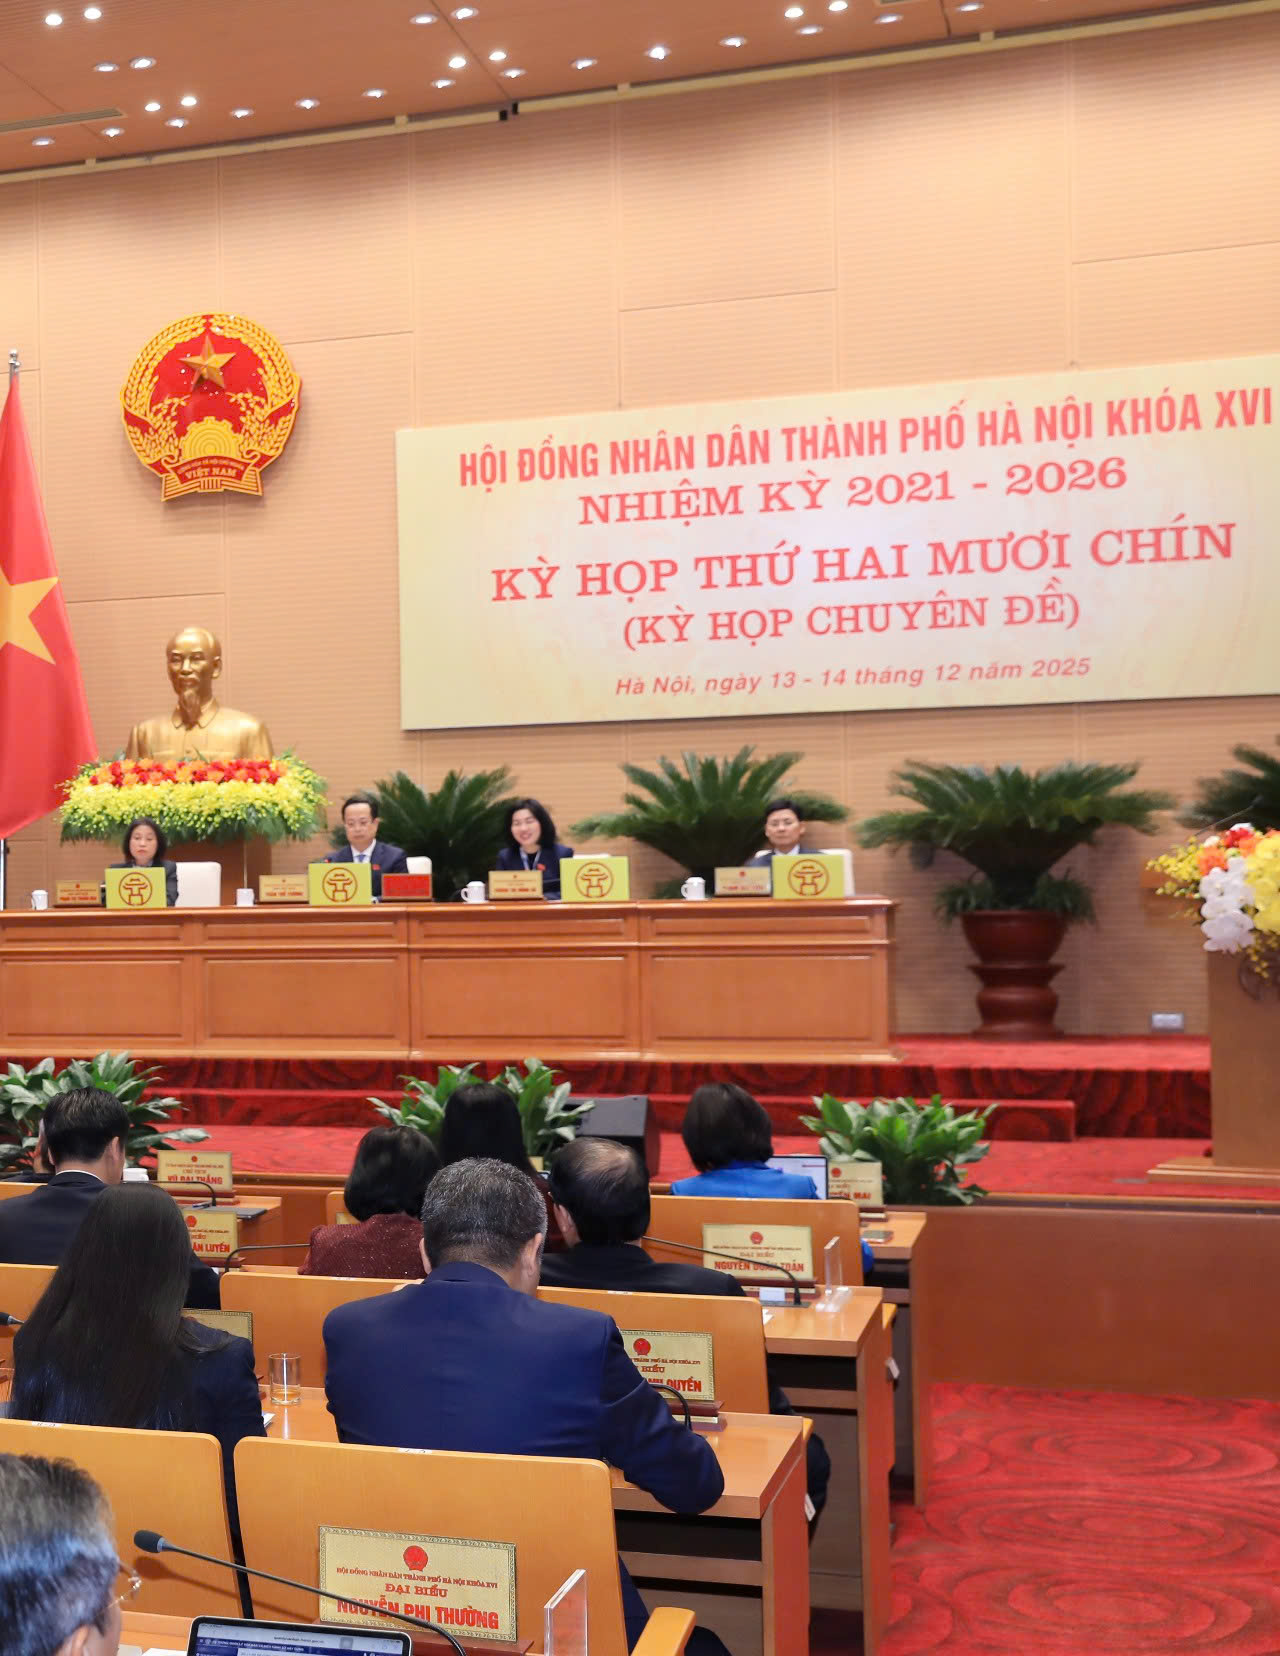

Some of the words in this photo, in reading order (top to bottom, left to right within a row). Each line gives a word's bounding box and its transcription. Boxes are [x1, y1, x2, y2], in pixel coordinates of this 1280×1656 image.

[461, 445, 506, 492] HỘI
[518, 435, 598, 482] ĐỒNG
[611, 430, 694, 474] NHÂN
[707, 424, 769, 467] DÂN
[782, 417, 886, 461] THÀNH
[900, 400, 964, 453] PHỐ
[979, 402, 1022, 446] HÀ
[1035, 397, 1092, 448] NỘI
[1107, 388, 1201, 436] KHÓA
[1216, 388, 1271, 428] XVI
[212, 467, 237, 477] NAM
[580, 479, 743, 526] NHIỆM
[760, 470, 830, 512] KỲ
[848, 471, 954, 506] 2021
[1007, 458, 1126, 495] 2026
[492, 556, 560, 601] KỲ
[576, 560, 677, 602] HỌP
[695, 541, 800, 589] THỨ
[813, 545, 909, 582] HAI
[928, 530, 1071, 575] MƯƠI
[1091, 514, 1236, 566] CHÍN
[624, 606, 694, 650] (KỲ
[709, 609, 792, 646] HỌP
[808, 590, 988, 635] CHUYÊN
[1004, 577, 1079, 628] ĐỀ)
[616, 679, 644, 694] Hà
[653, 677, 694, 693] Nội,
[705, 676, 761, 696] ngày
[773, 672, 795, 688] 13
[824, 669, 846, 685] 14
[856, 669, 924, 687] tháng
[937, 664, 960, 680] 12
[970, 663, 1022, 680] năm
[1032, 658, 1090, 677] 2025
[349, 1566, 368, 1576] ĐỒNG
[369, 1568, 388, 1578] NHÂN
[388, 1571, 403, 1580] DÂN
[403, 1572, 427, 1582] THÀNH
[427, 1575, 441, 1583] PHỐ
[385, 1583, 411, 1595] ĐẠI
[414, 1583, 448, 1598] BIỂU
[336, 1594, 400, 1618] NGUYỄN
[403, 1603, 431, 1624] PHI
[435, 1605, 500, 1630] THƯỜNG
